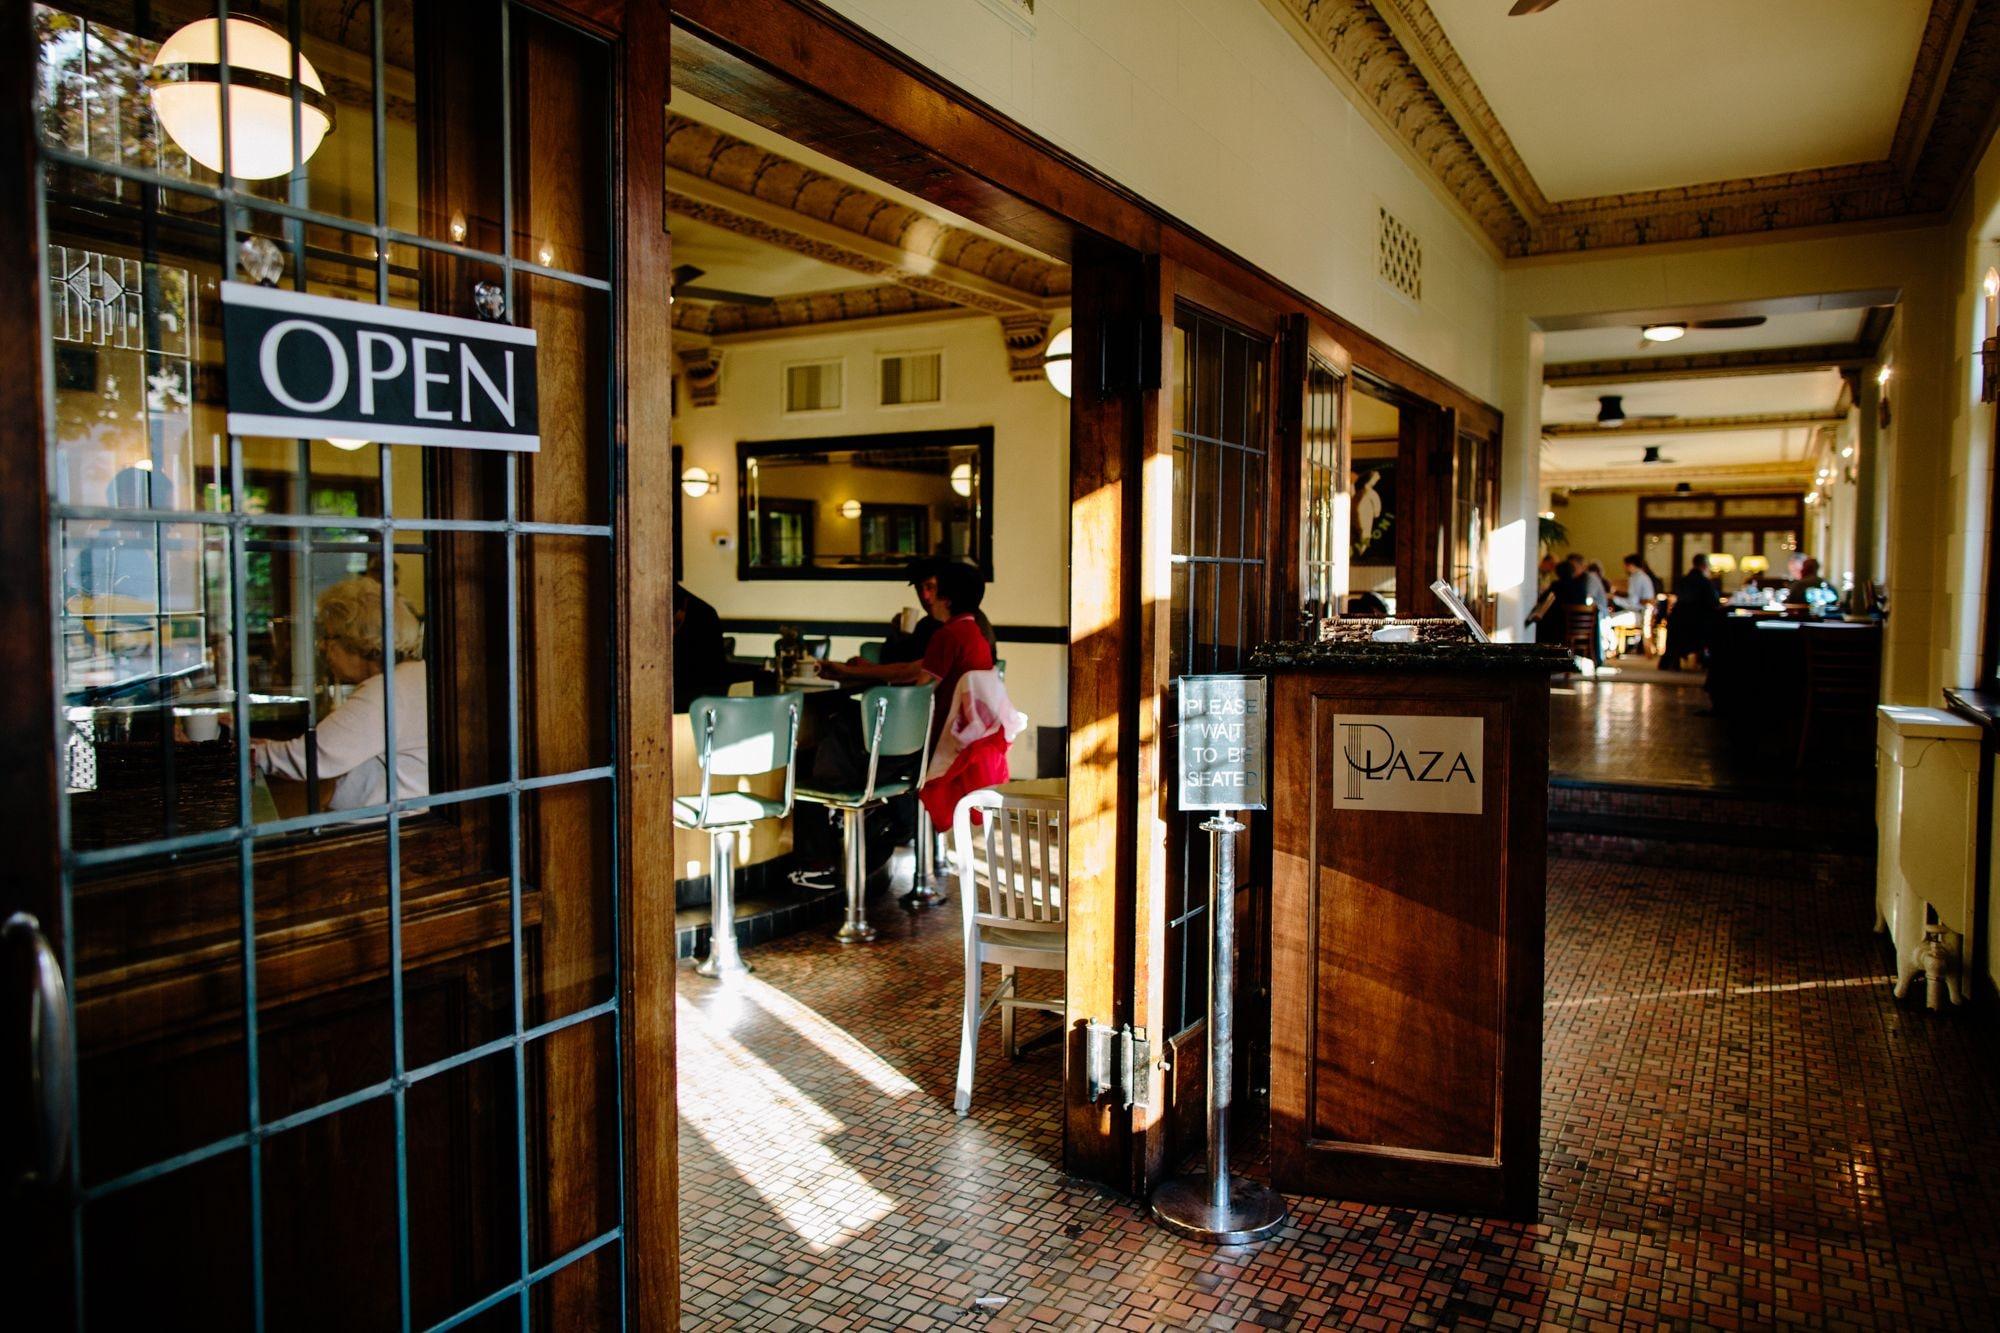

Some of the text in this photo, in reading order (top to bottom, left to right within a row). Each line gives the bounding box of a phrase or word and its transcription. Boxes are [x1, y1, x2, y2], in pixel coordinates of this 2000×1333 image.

[259, 319, 515, 427] OPEN
[1186, 699, 1258, 715] PLEASE
[1200, 723, 1245, 739] WAIT
[1192, 747, 1253, 763] TO BE
[1340, 723, 1476, 800] PLAZA
[1187, 771, 1258, 787] SEATED
